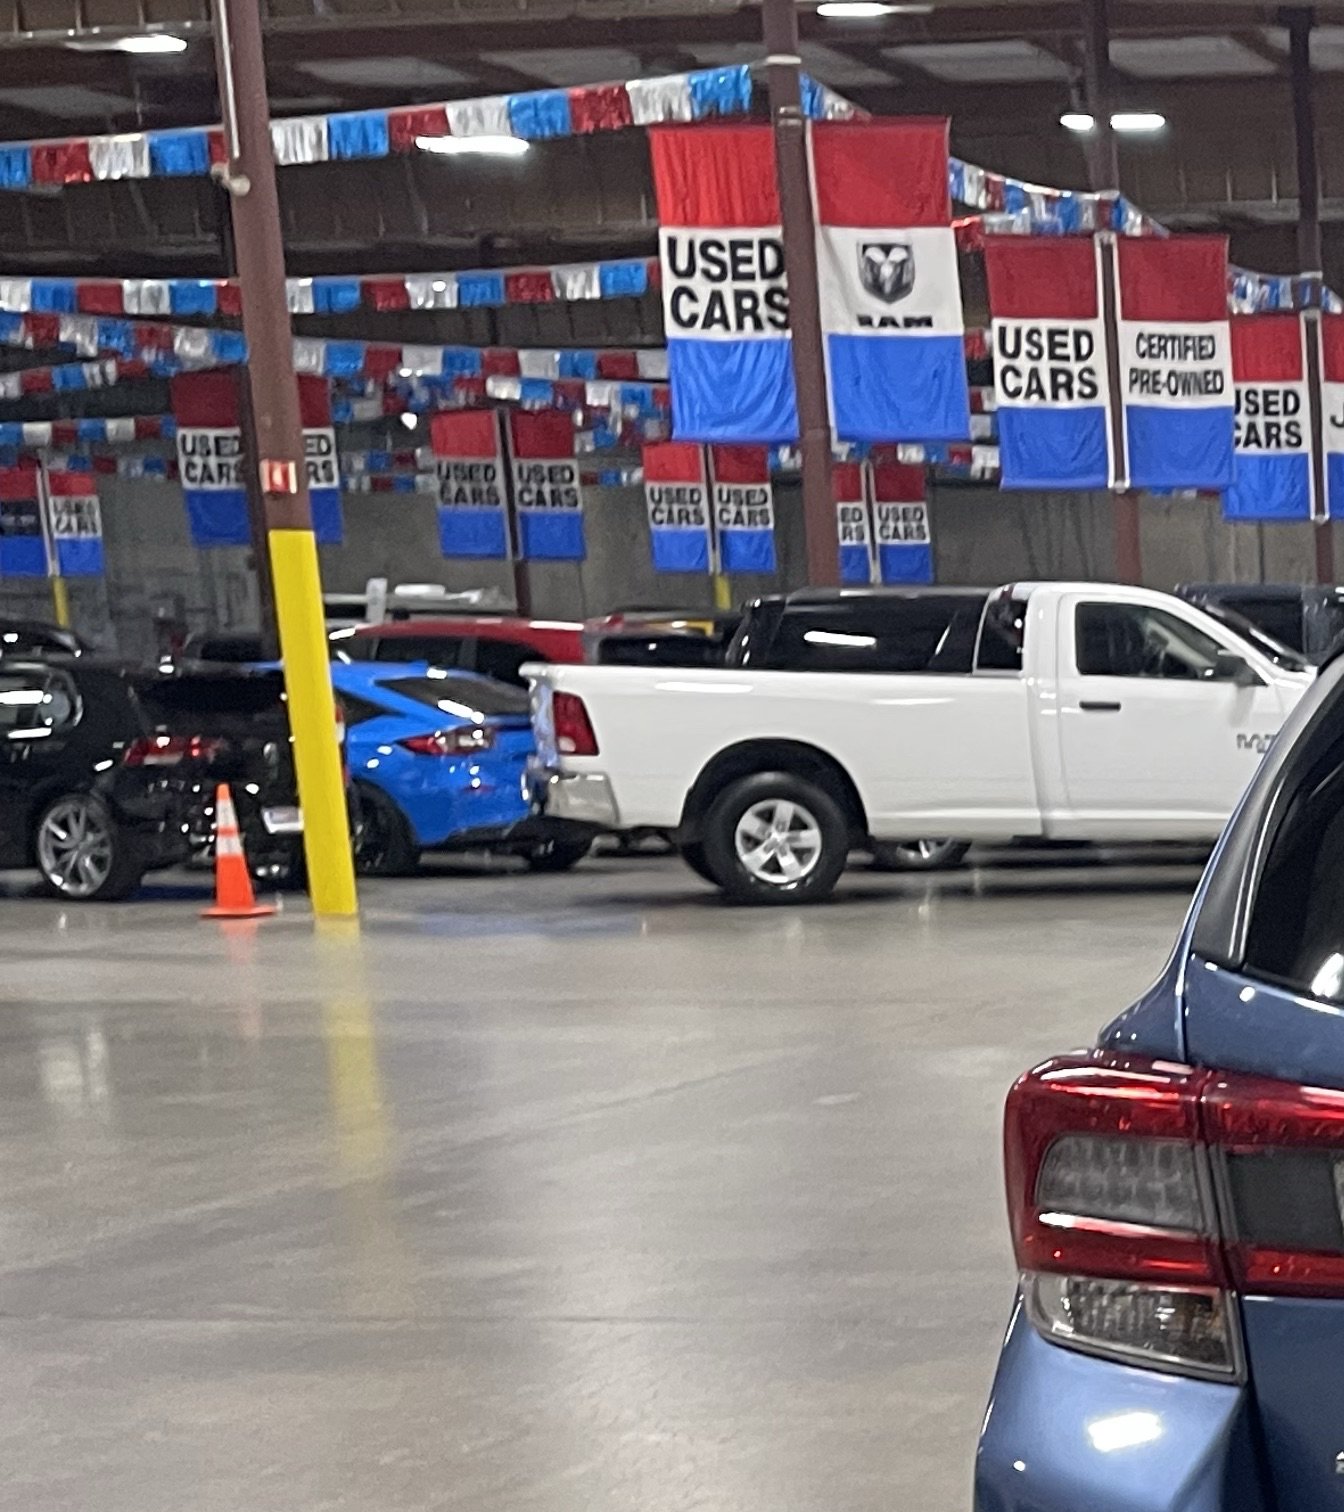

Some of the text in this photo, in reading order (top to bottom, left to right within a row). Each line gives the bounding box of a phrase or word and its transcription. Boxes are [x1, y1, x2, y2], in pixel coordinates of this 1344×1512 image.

[667, 236, 785, 283] USED
[670, 286, 790, 331] CARS
[998, 326, 1094, 362] USED
[1136, 332, 1216, 360] CERTIFIED
[1000, 364, 1099, 400] CARS
[1129, 367, 1224, 396] PRE-OWNED
